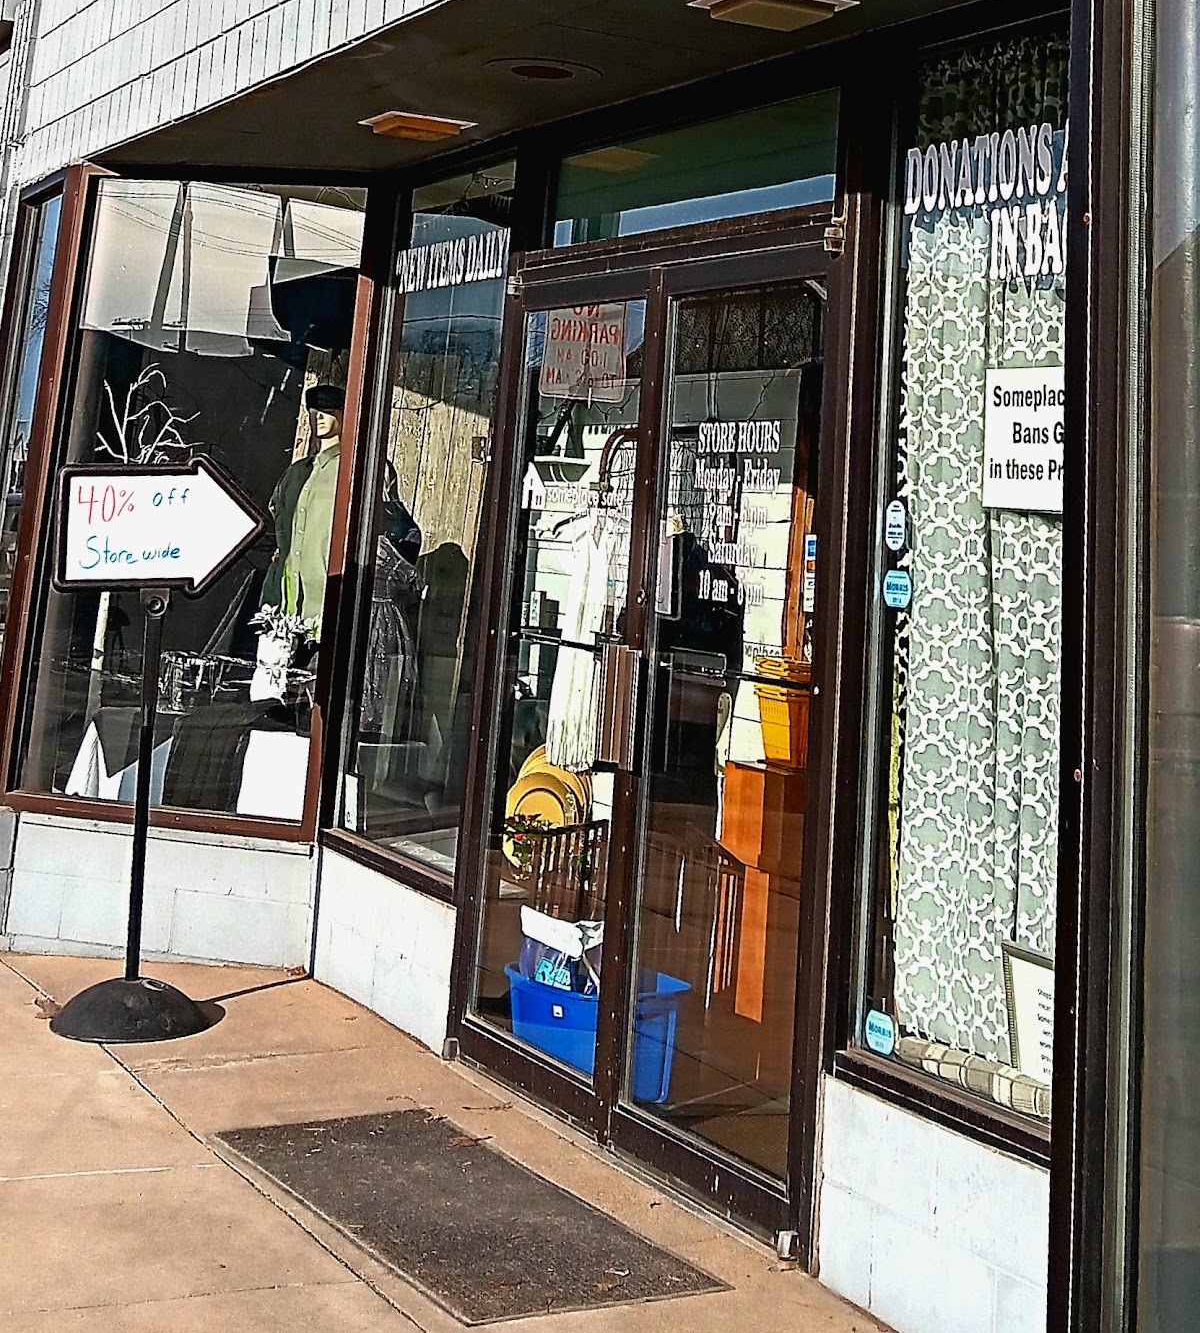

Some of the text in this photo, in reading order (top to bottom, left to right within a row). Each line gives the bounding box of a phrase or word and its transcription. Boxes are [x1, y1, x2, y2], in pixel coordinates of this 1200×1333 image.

[904, 123, 1053, 215] DONATIONS
[989, 198, 1069, 281] IN BA
[427, 237, 466, 290] ITEMS
[697, 420, 781, 453] STORE HOURS
[1012, 421, 1049, 444] Bans
[694, 458, 736, 497] Monday
[742, 458, 781, 500] Friday
[989, 458, 1002, 479] in
[1006, 458, 1044, 480] these
[78, 484, 190, 524] 40% off
[546, 484, 625, 508] someplace safe
[707, 533, 758, 574] Saturday
[698, 569, 711, 599] 10
[712, 578, 728, 602] am
